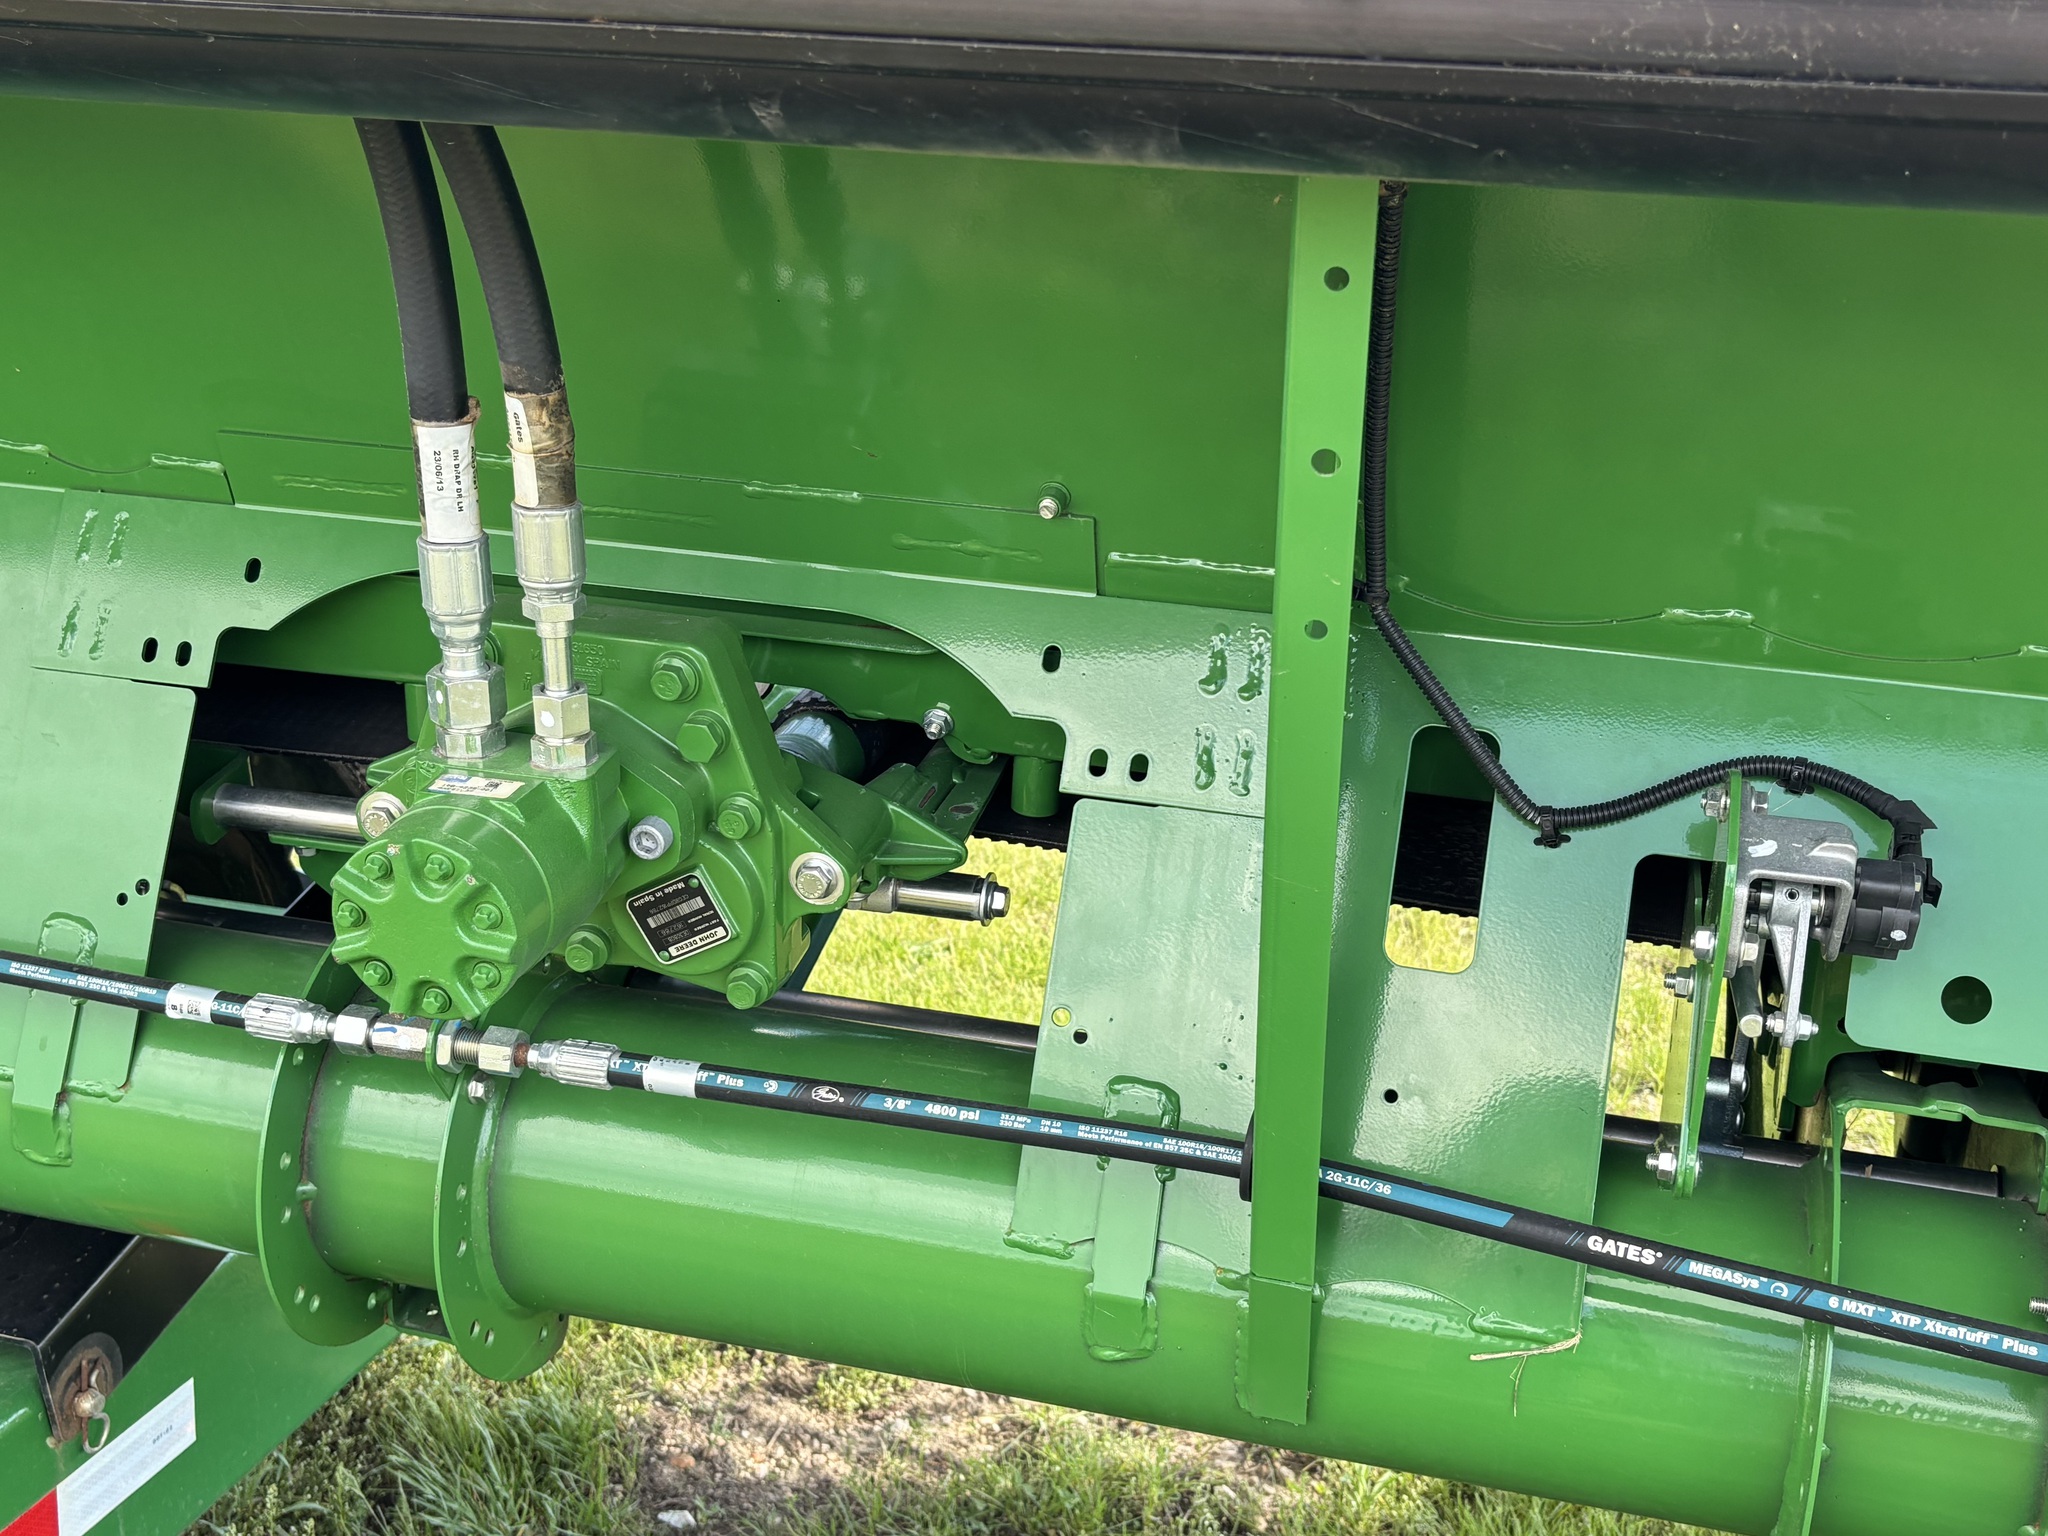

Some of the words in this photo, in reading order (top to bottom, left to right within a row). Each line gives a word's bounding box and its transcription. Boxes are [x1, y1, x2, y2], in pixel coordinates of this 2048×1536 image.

[513, 412, 523, 443] Gates
[452, 449, 460, 461] RH
[433, 450, 444, 491] 23/06/13
[456, 488, 463, 499] DR
[457, 501, 464, 512] LH
[664, 882, 685, 893] Made
[633, 896, 655, 907] Spain
[698, 930, 718, 943] JOHN
[675, 940, 698, 952] DEERE
[27, 970, 61, 982] Performance
[717, 1074, 744, 1087] Plus
[883, 1097, 911, 1110] 3/8"
[924, 1103, 957, 1118] 4800
[959, 1110, 980, 1121] psi
[1016, 1116, 1031, 1124] MPa
[1078, 1124, 1090, 1132] ISO
[1013, 1121, 1025, 1129] Bar
[1078, 1130, 1098, 1139] Meets
[1100, 1134, 1143, 1146] Performance
[1203, 1150, 1217, 1158] SAE
[1325, 1170, 1392, 1195] 2G-11C/36
[1828, 1296, 1839, 1309] 6
[1890, 1310, 1922, 1327] XTP
[2002, 1337, 2038, 1356] Plus
